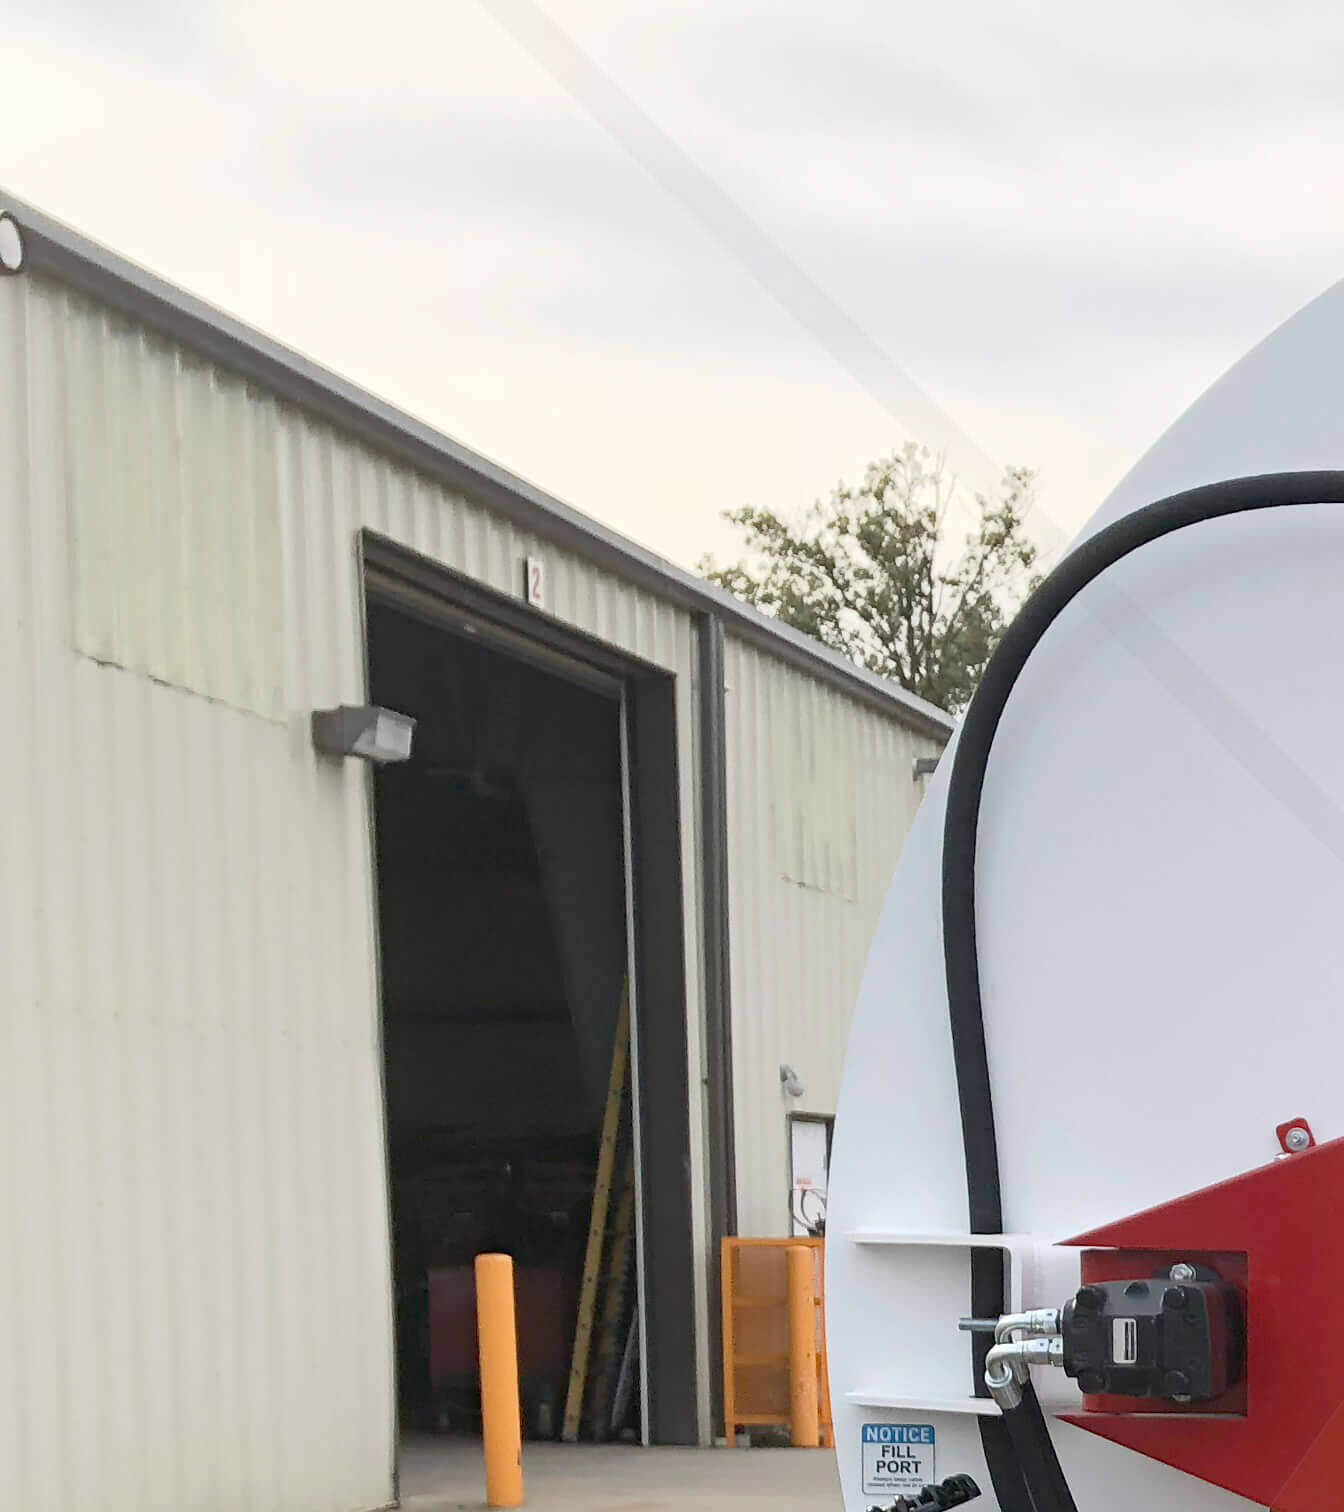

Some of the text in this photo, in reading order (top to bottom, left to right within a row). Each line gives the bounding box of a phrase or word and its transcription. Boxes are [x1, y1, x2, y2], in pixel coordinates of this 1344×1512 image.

[531, 567, 541, 600] 2
[866, 1426, 930, 1442] NOTICE
[881, 1444, 916, 1458] FILL
[876, 1460, 922, 1473] PORT
